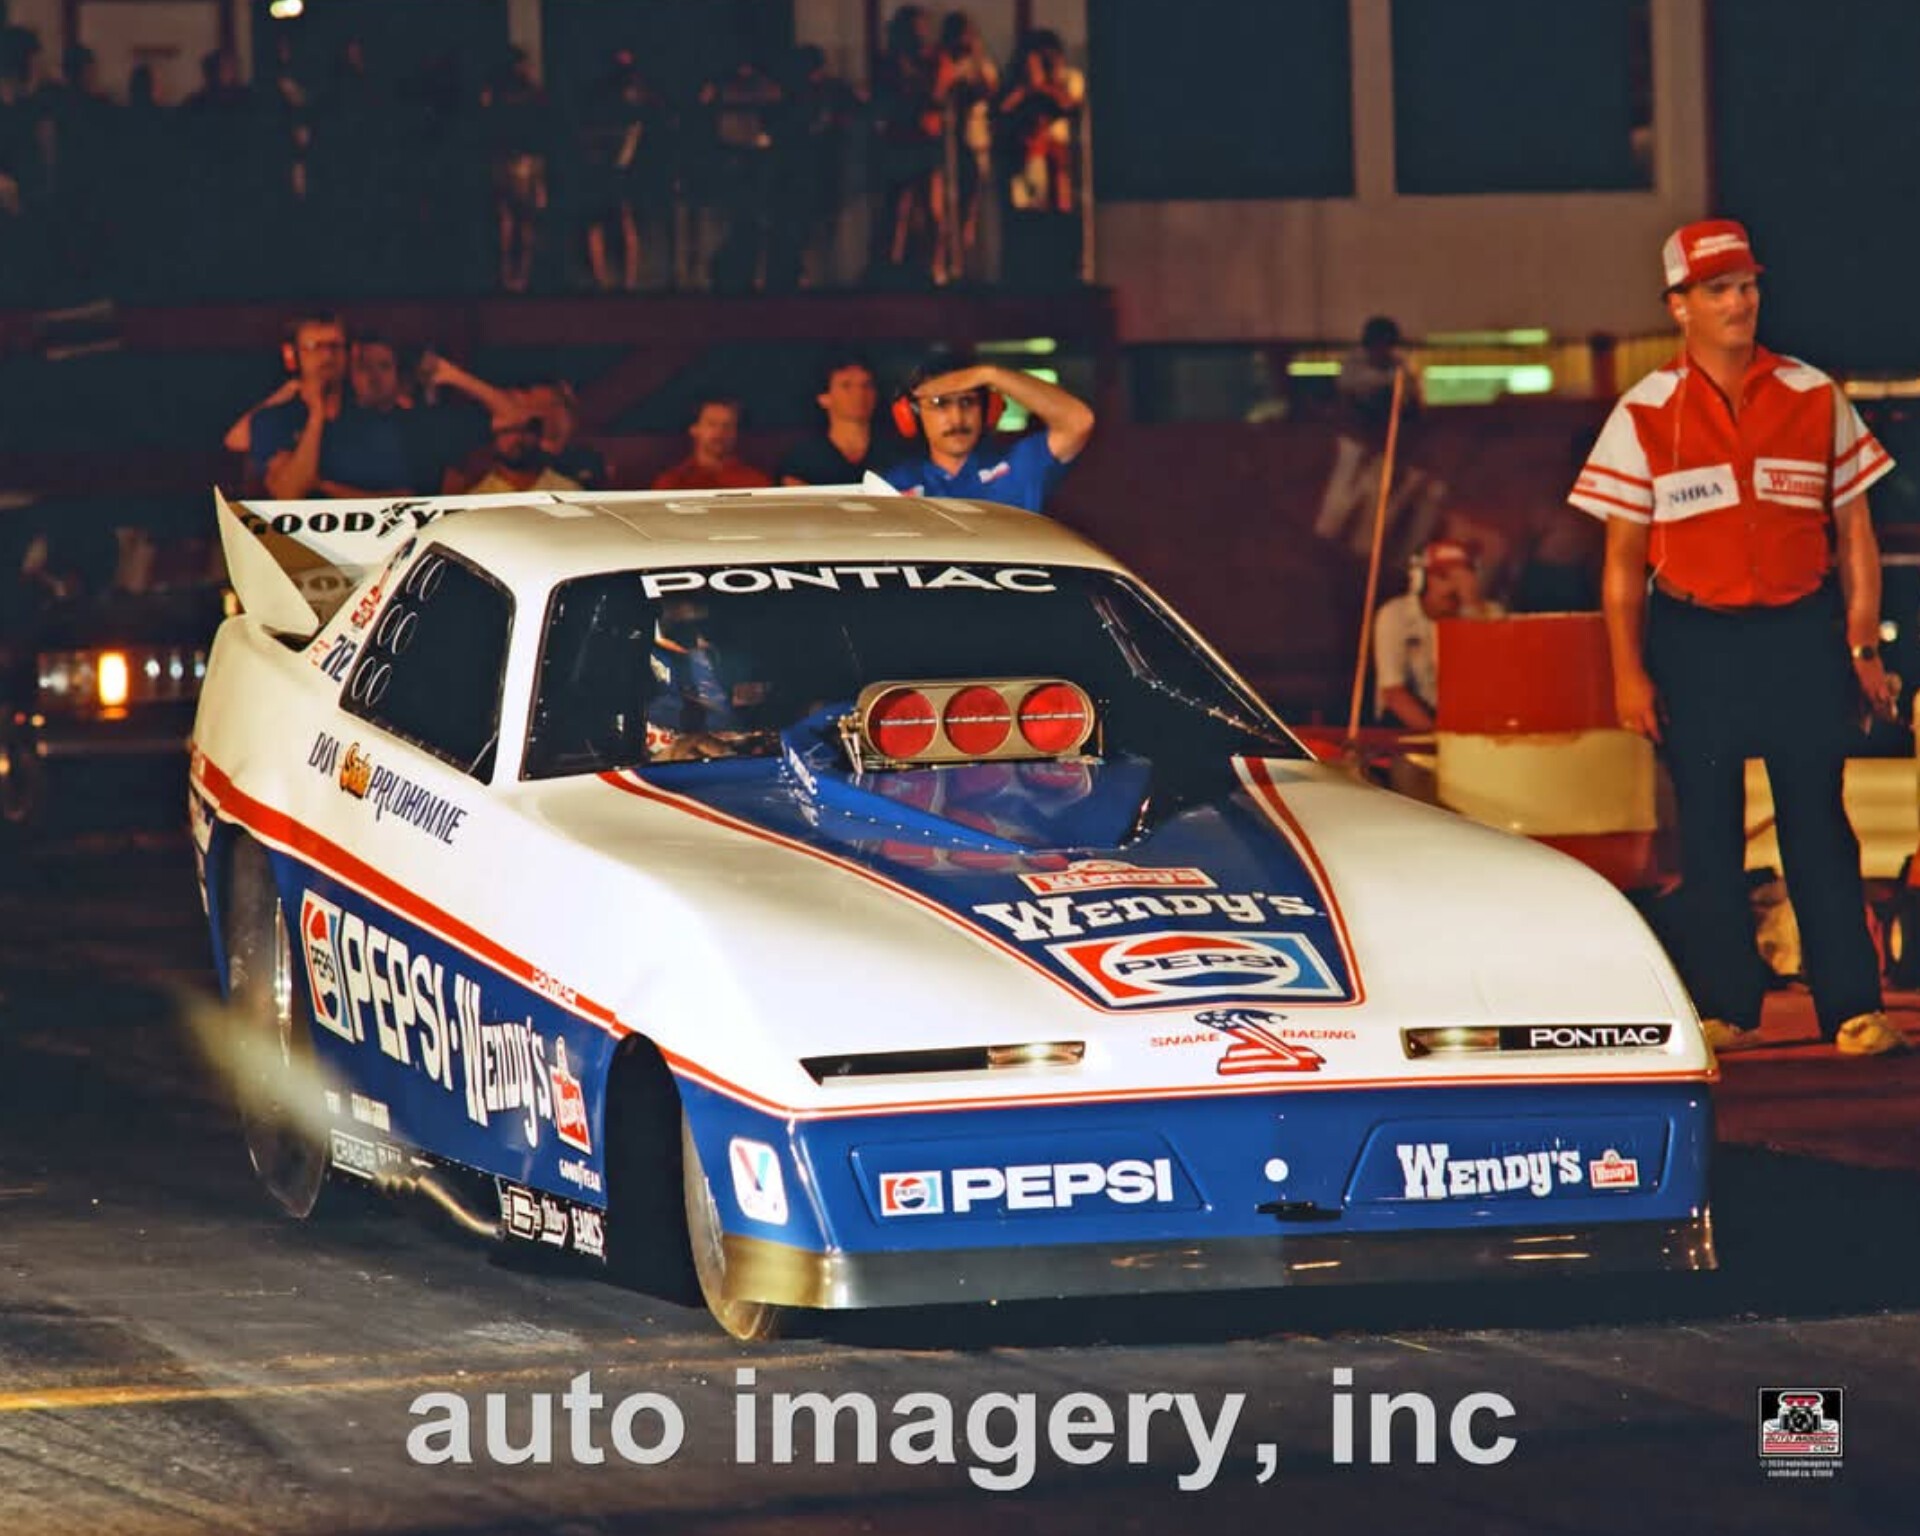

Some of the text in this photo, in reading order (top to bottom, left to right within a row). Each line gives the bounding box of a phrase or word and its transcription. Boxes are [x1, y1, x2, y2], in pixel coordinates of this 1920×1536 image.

[1668, 482, 1724, 503] NHRA
[640, 565, 1056, 599] PONTIAC
[308, 731, 340, 777] DON
[1114, 952, 1287, 976] PEPSI
[341, 911, 453, 1092] PEPSI
[1151, 1029, 1356, 1047] SNAKE RACING
[1529, 1026, 1661, 1048] PONTIAC
[951, 1158, 1174, 1213] PEPSI
